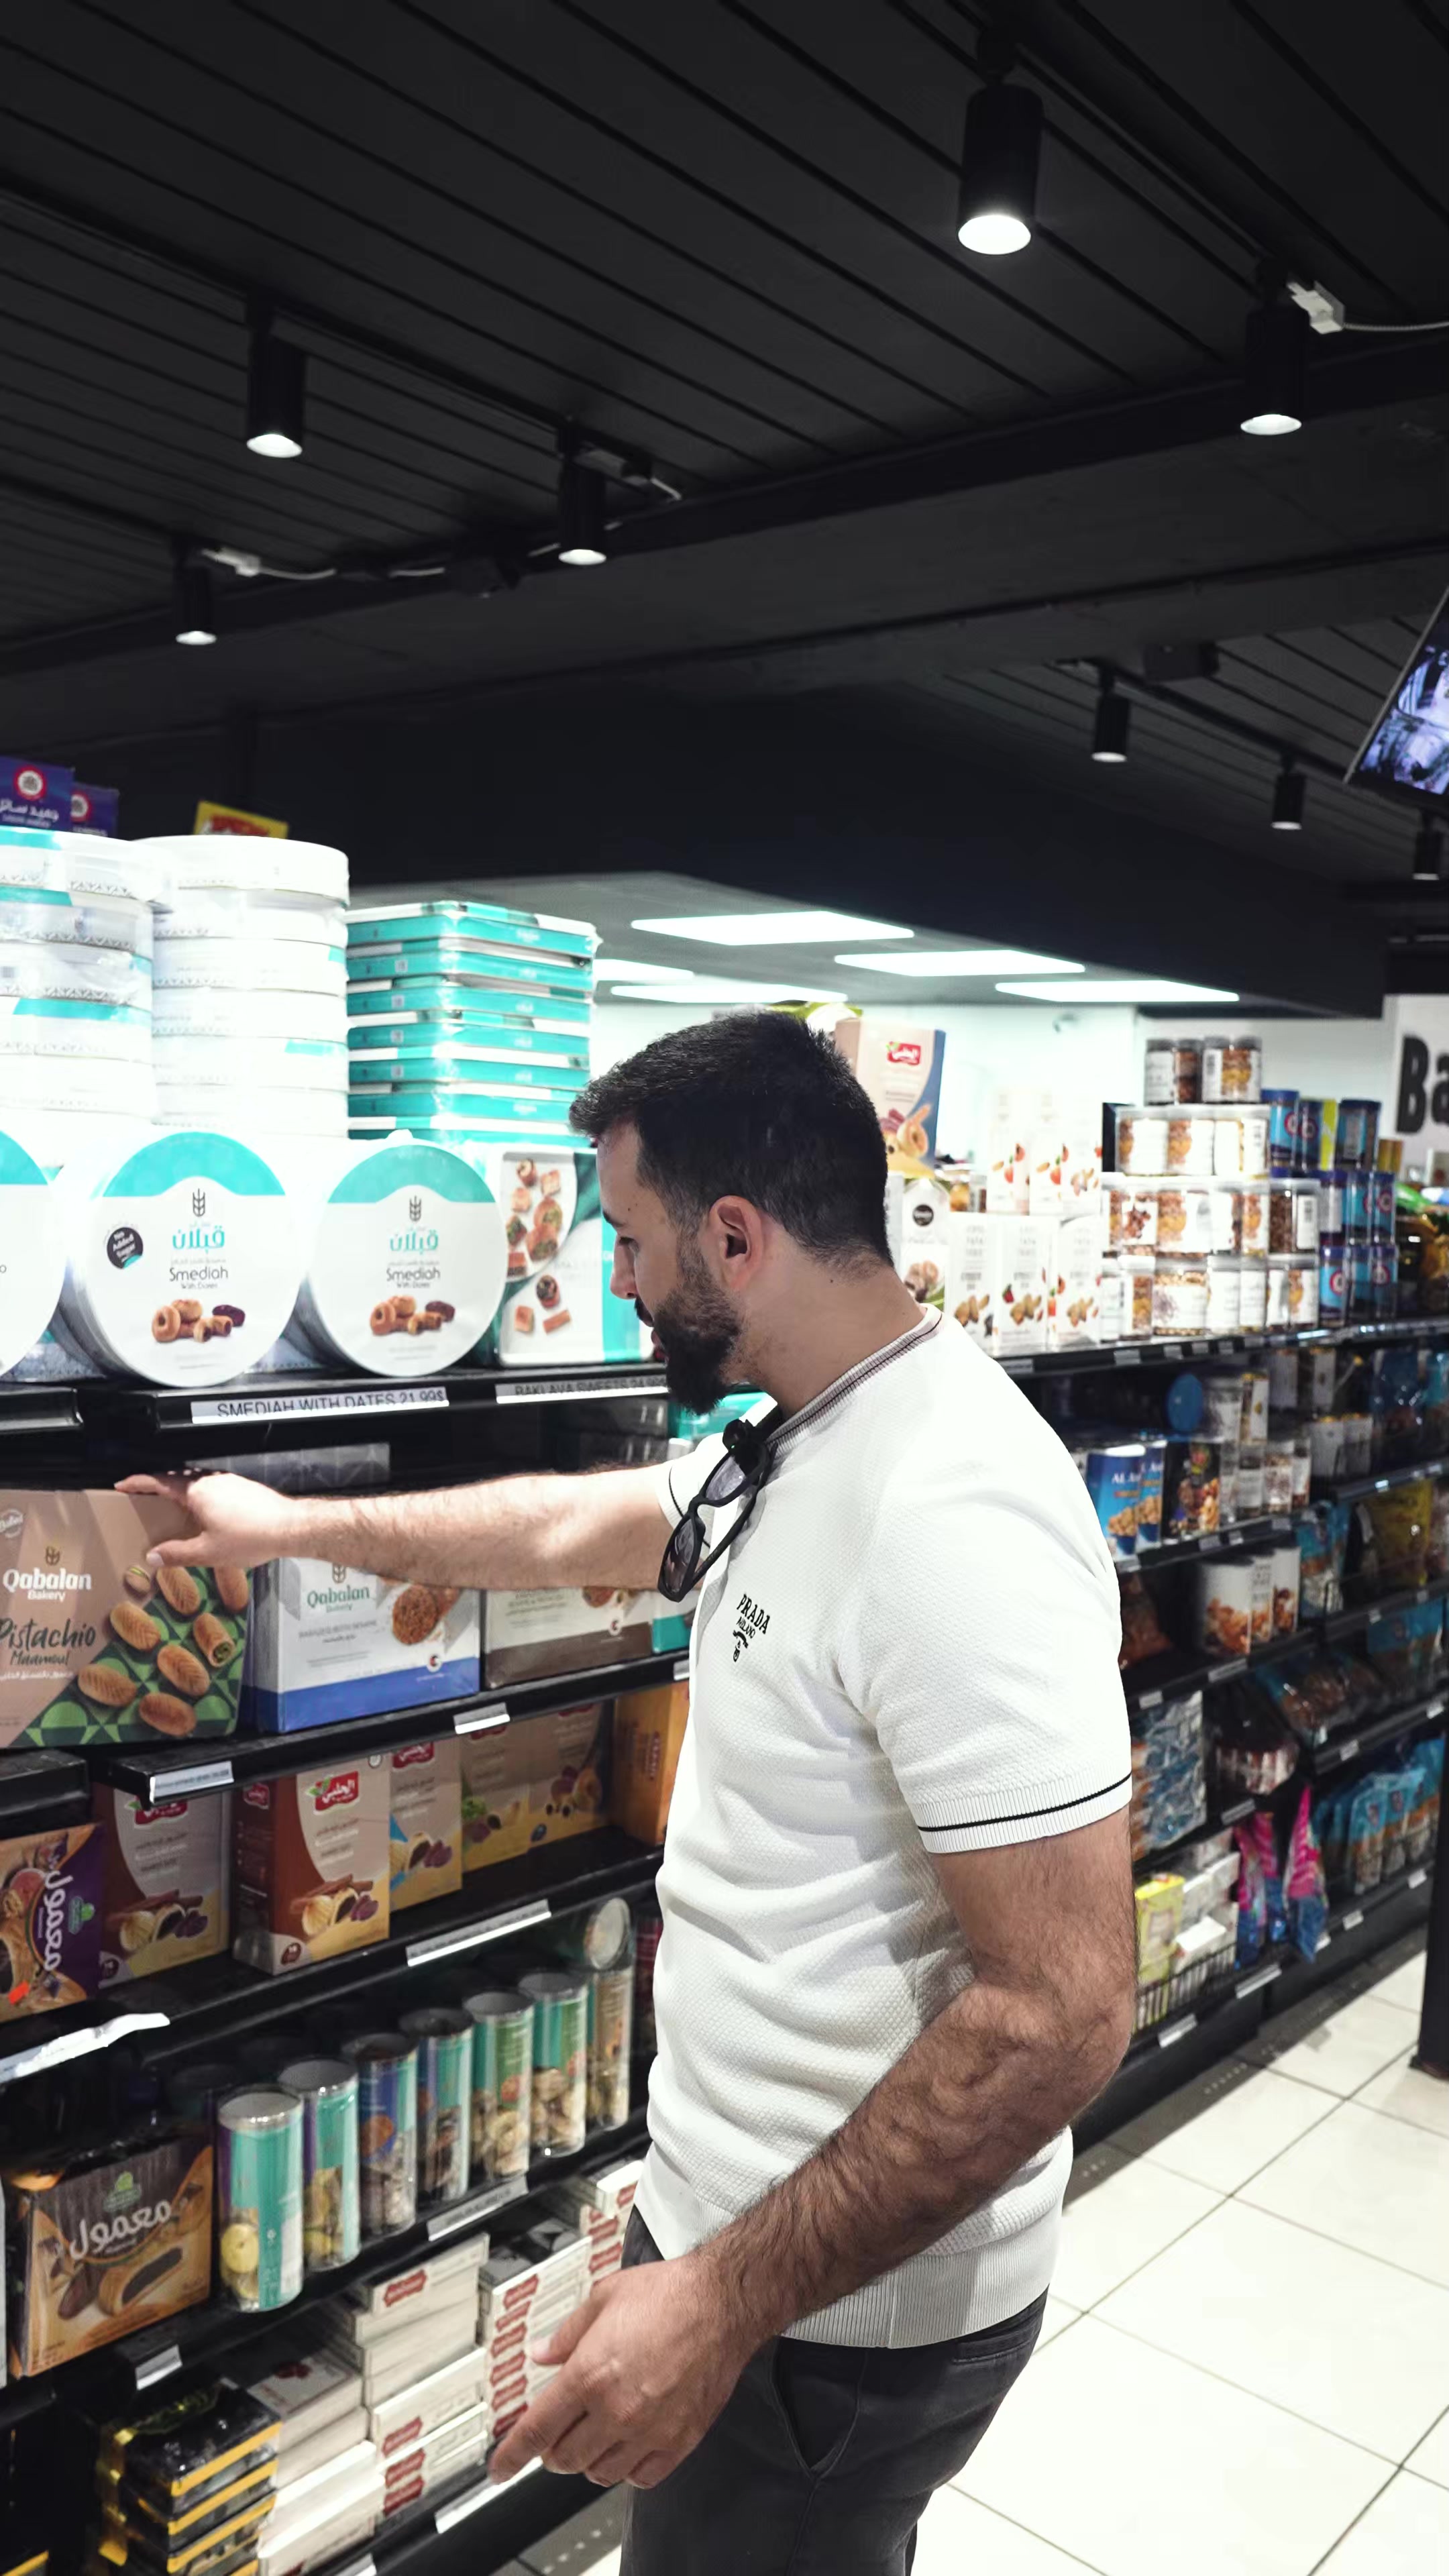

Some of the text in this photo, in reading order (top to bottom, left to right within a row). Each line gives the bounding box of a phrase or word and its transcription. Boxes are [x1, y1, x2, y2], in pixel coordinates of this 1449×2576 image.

[172, 1225, 225, 1254] قبلان
[169, 1265, 229, 1282] Smediah
[386, 1267, 441, 1282] Smediah
[217, 1399, 294, 1417] SMEDIAH
[299, 1397, 339, 1411] WITH
[344, 1392, 396, 1407] DATES
[3, 1567, 92, 1593] Qabalan
[28, 1589, 66, 1603] Bakery
[307, 1584, 371, 1609] Qabalan
[736, 1593, 771, 1635] PRADA
[0, 1617, 96, 1652] Pistachio
[736, 1616, 756, 1639] MILANO
[10, 1650, 70, 1666] Maamoul
[44, 1870, 74, 1972] معمول
[70, 2200, 172, 2260] معمول
